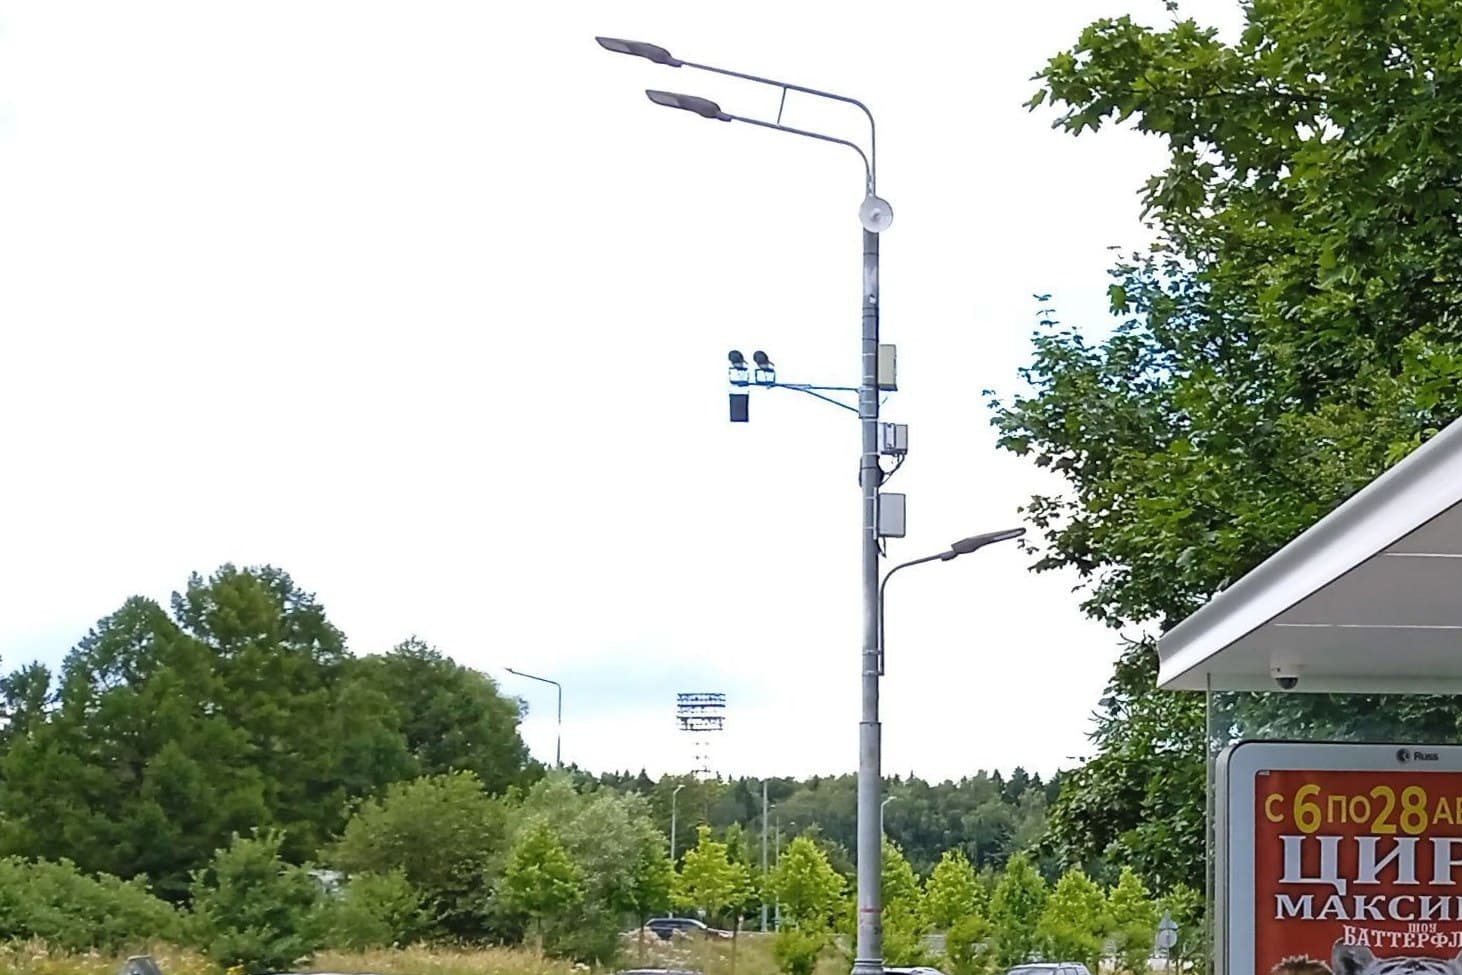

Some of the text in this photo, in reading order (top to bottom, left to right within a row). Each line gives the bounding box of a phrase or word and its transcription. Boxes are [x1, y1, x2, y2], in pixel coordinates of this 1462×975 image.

[1265, 794, 1285, 823] С
[1293, 784, 1322, 834] 6
[1327, 795, 1371, 825] ПО
[1370, 785, 1429, 834] 28
[1408, 922, 1437, 933] ШОУ
